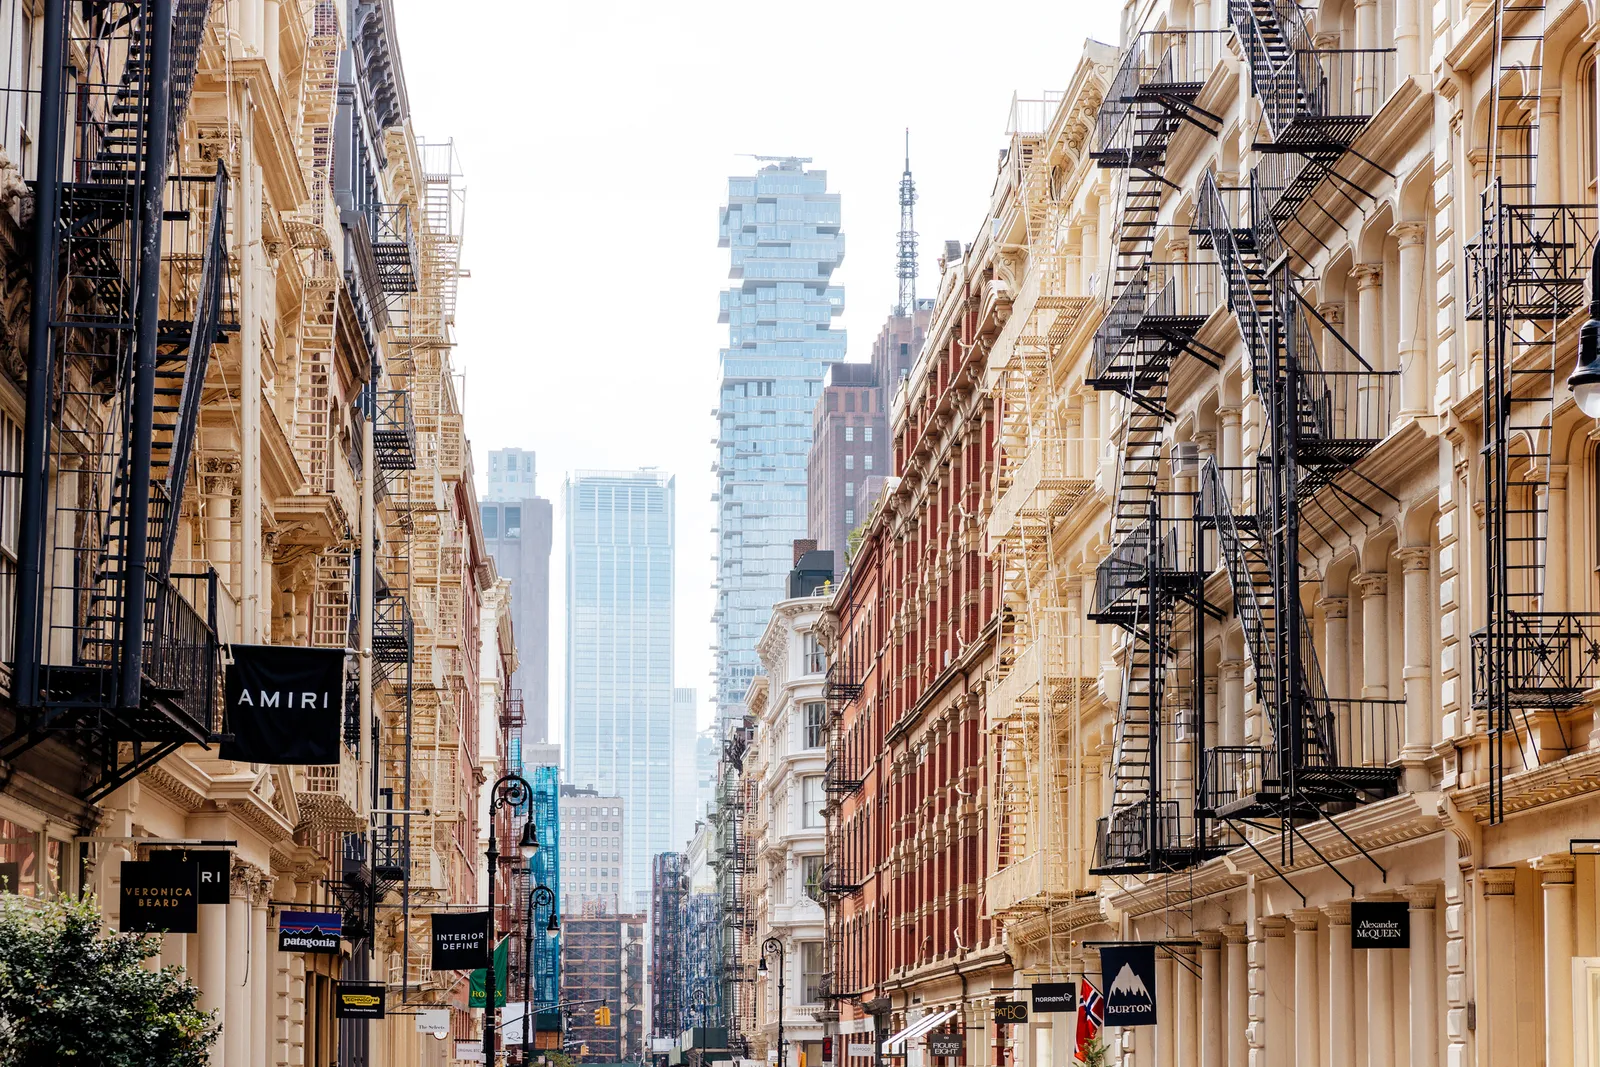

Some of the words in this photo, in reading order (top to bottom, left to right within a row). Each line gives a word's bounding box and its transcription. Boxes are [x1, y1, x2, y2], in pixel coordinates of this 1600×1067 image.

[238, 688, 328, 709] AMIRI
[125, 887, 192, 897] VERONICA
[138, 898, 179, 908] BEARD
[1359, 920, 1399, 929] Alexander
[436, 932, 484, 941] INTERIOR
[1356, 929, 1401, 940] McQUEEN
[283, 937, 336, 949] patagonia
[442, 941, 479, 951] DEFINE
[1108, 1004, 1152, 1014] BURTON
